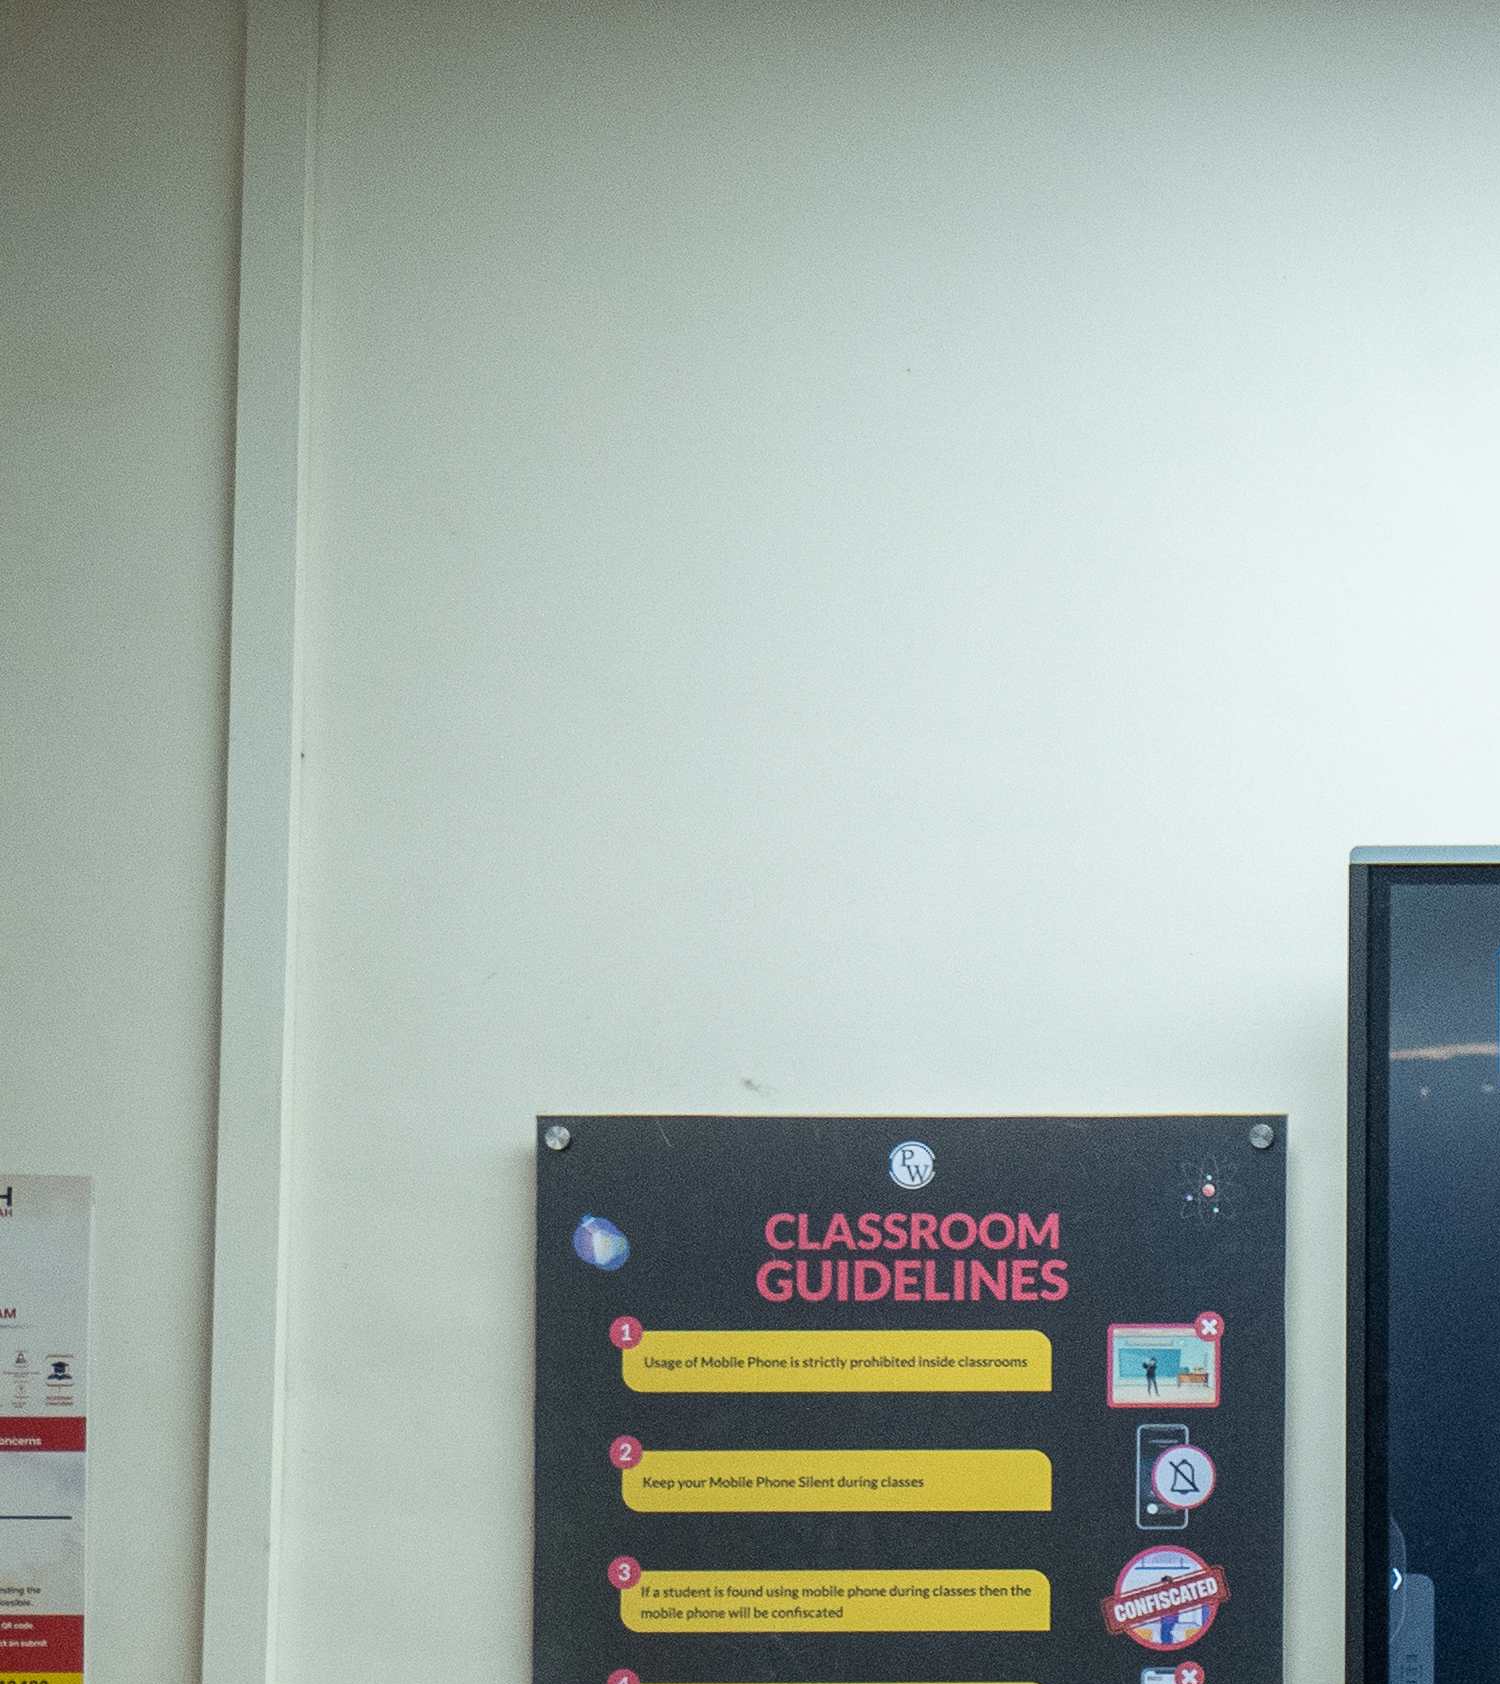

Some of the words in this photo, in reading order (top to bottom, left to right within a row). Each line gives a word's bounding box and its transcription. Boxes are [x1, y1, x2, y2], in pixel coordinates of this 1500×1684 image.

[764, 1211, 1060, 1251] CLASSROOM
[756, 1258, 1069, 1302] GUIDELINES
[621, 1323, 632, 1342] 1
[643, 1356, 683, 1372] Usage
[683, 1355, 699, 1369] of
[700, 1355, 746, 1369] Mobile
[746, 1356, 788, 1369] Phone
[789, 1355, 800, 1369] is
[801, 1355, 848, 1370] strictly
[849, 1355, 916, 1370] prohibited
[918, 1356, 956, 1368] inside
[957, 1356, 1028, 1368] classrooms
[619, 1443, 632, 1462] 2
[642, 1476, 676, 1491] Keep
[676, 1479, 707, 1491] your
[708, 1476, 754, 1489] Mobile
[755, 1475, 796, 1489] Phone
[797, 1475, 835, 1489] Silent
[836, 1475, 879, 1491] during
[880, 1476, 925, 1488] classes
[618, 1562, 631, 1582] 3
[640, 1585, 651, 1598] If
[652, 1588, 661, 1599] a
[662, 1585, 712, 1599] student
[713, 1585, 725, 1598] is
[726, 1585, 764, 1598] found
[765, 1585, 800, 1601] using
[801, 1585, 845, 1598] mobile
[846, 1585, 887, 1600] phone
[888, 1584, 931, 1600] during
[931, 1585, 977, 1598] classes
[978, 1584, 1009, 1597] then
[1010, 1584, 1032, 1597] the
[1113, 1577, 1219, 1622] CONFISCATED
[640, 1606, 684, 1620] mobile
[685, 1606, 726, 1622] phone
[727, 1606, 751, 1619] will
[753, 1606, 769, 1620] be
[770, 1606, 844, 1619] confiscated
